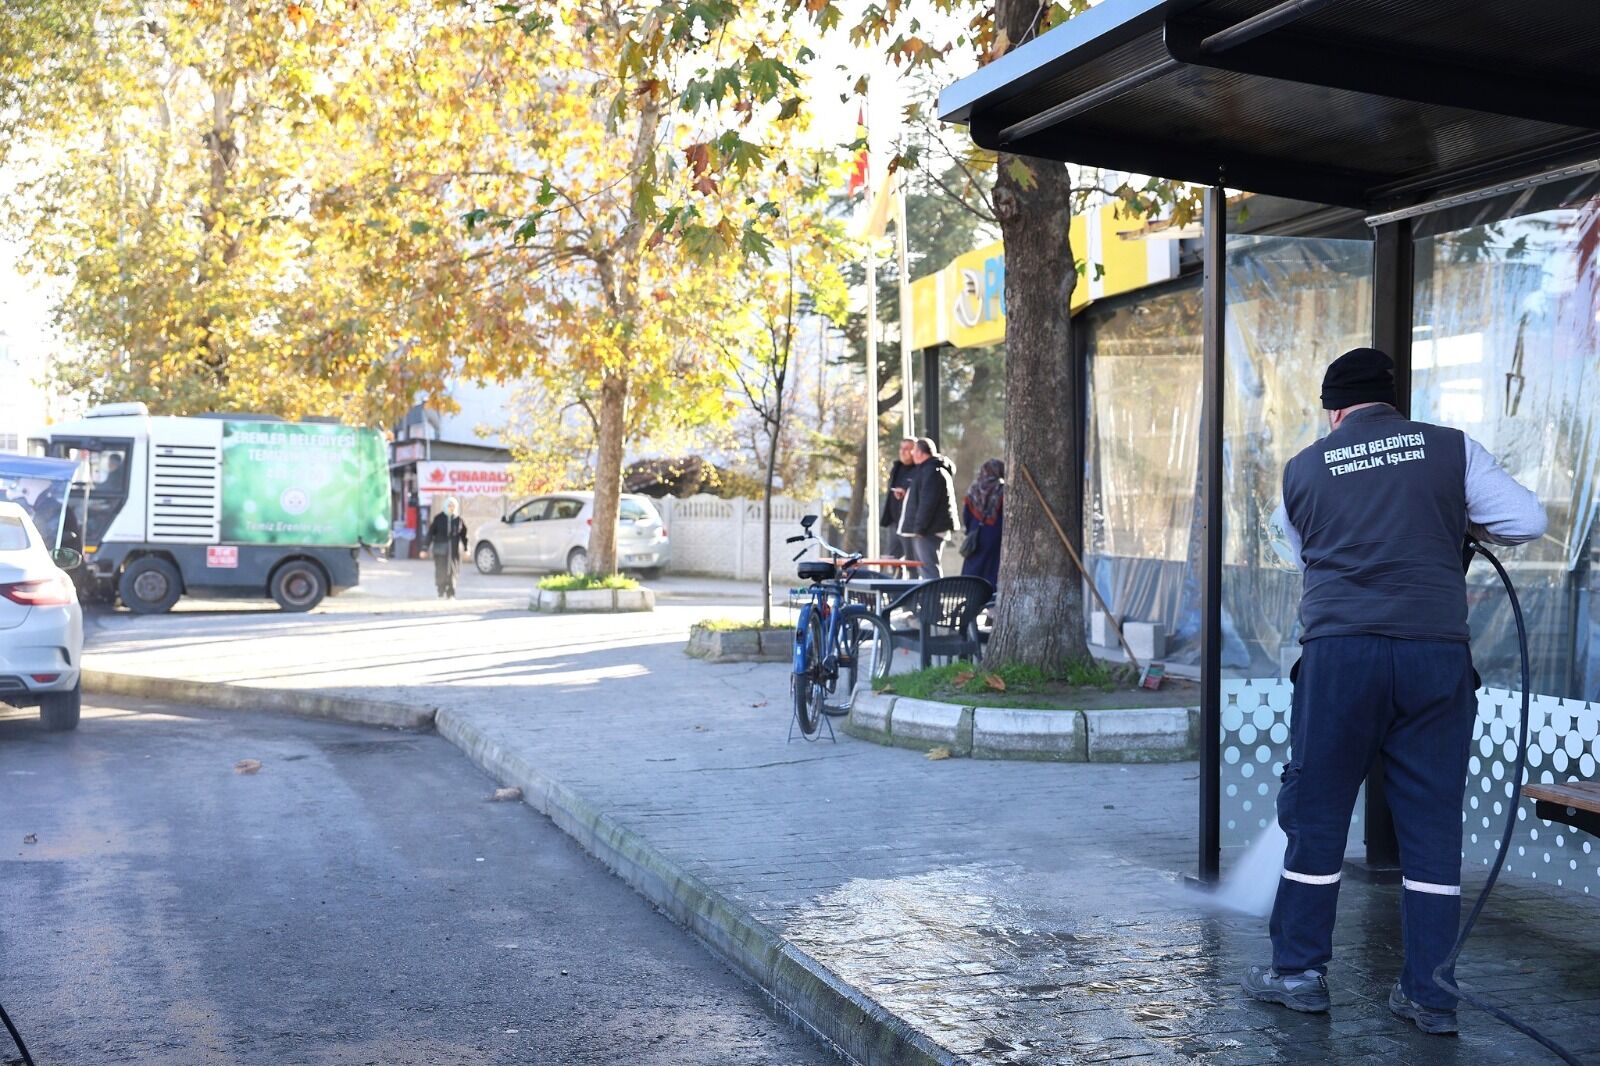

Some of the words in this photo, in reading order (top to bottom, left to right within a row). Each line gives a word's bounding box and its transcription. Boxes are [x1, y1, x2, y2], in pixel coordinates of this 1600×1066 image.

[1324, 443, 1369, 464] ERENLER
[1369, 432, 1425, 453] BELEDİYESİ
[1329, 456, 1385, 476] TEMİZLİK
[1387, 448, 1425, 465] İŞLERİ
